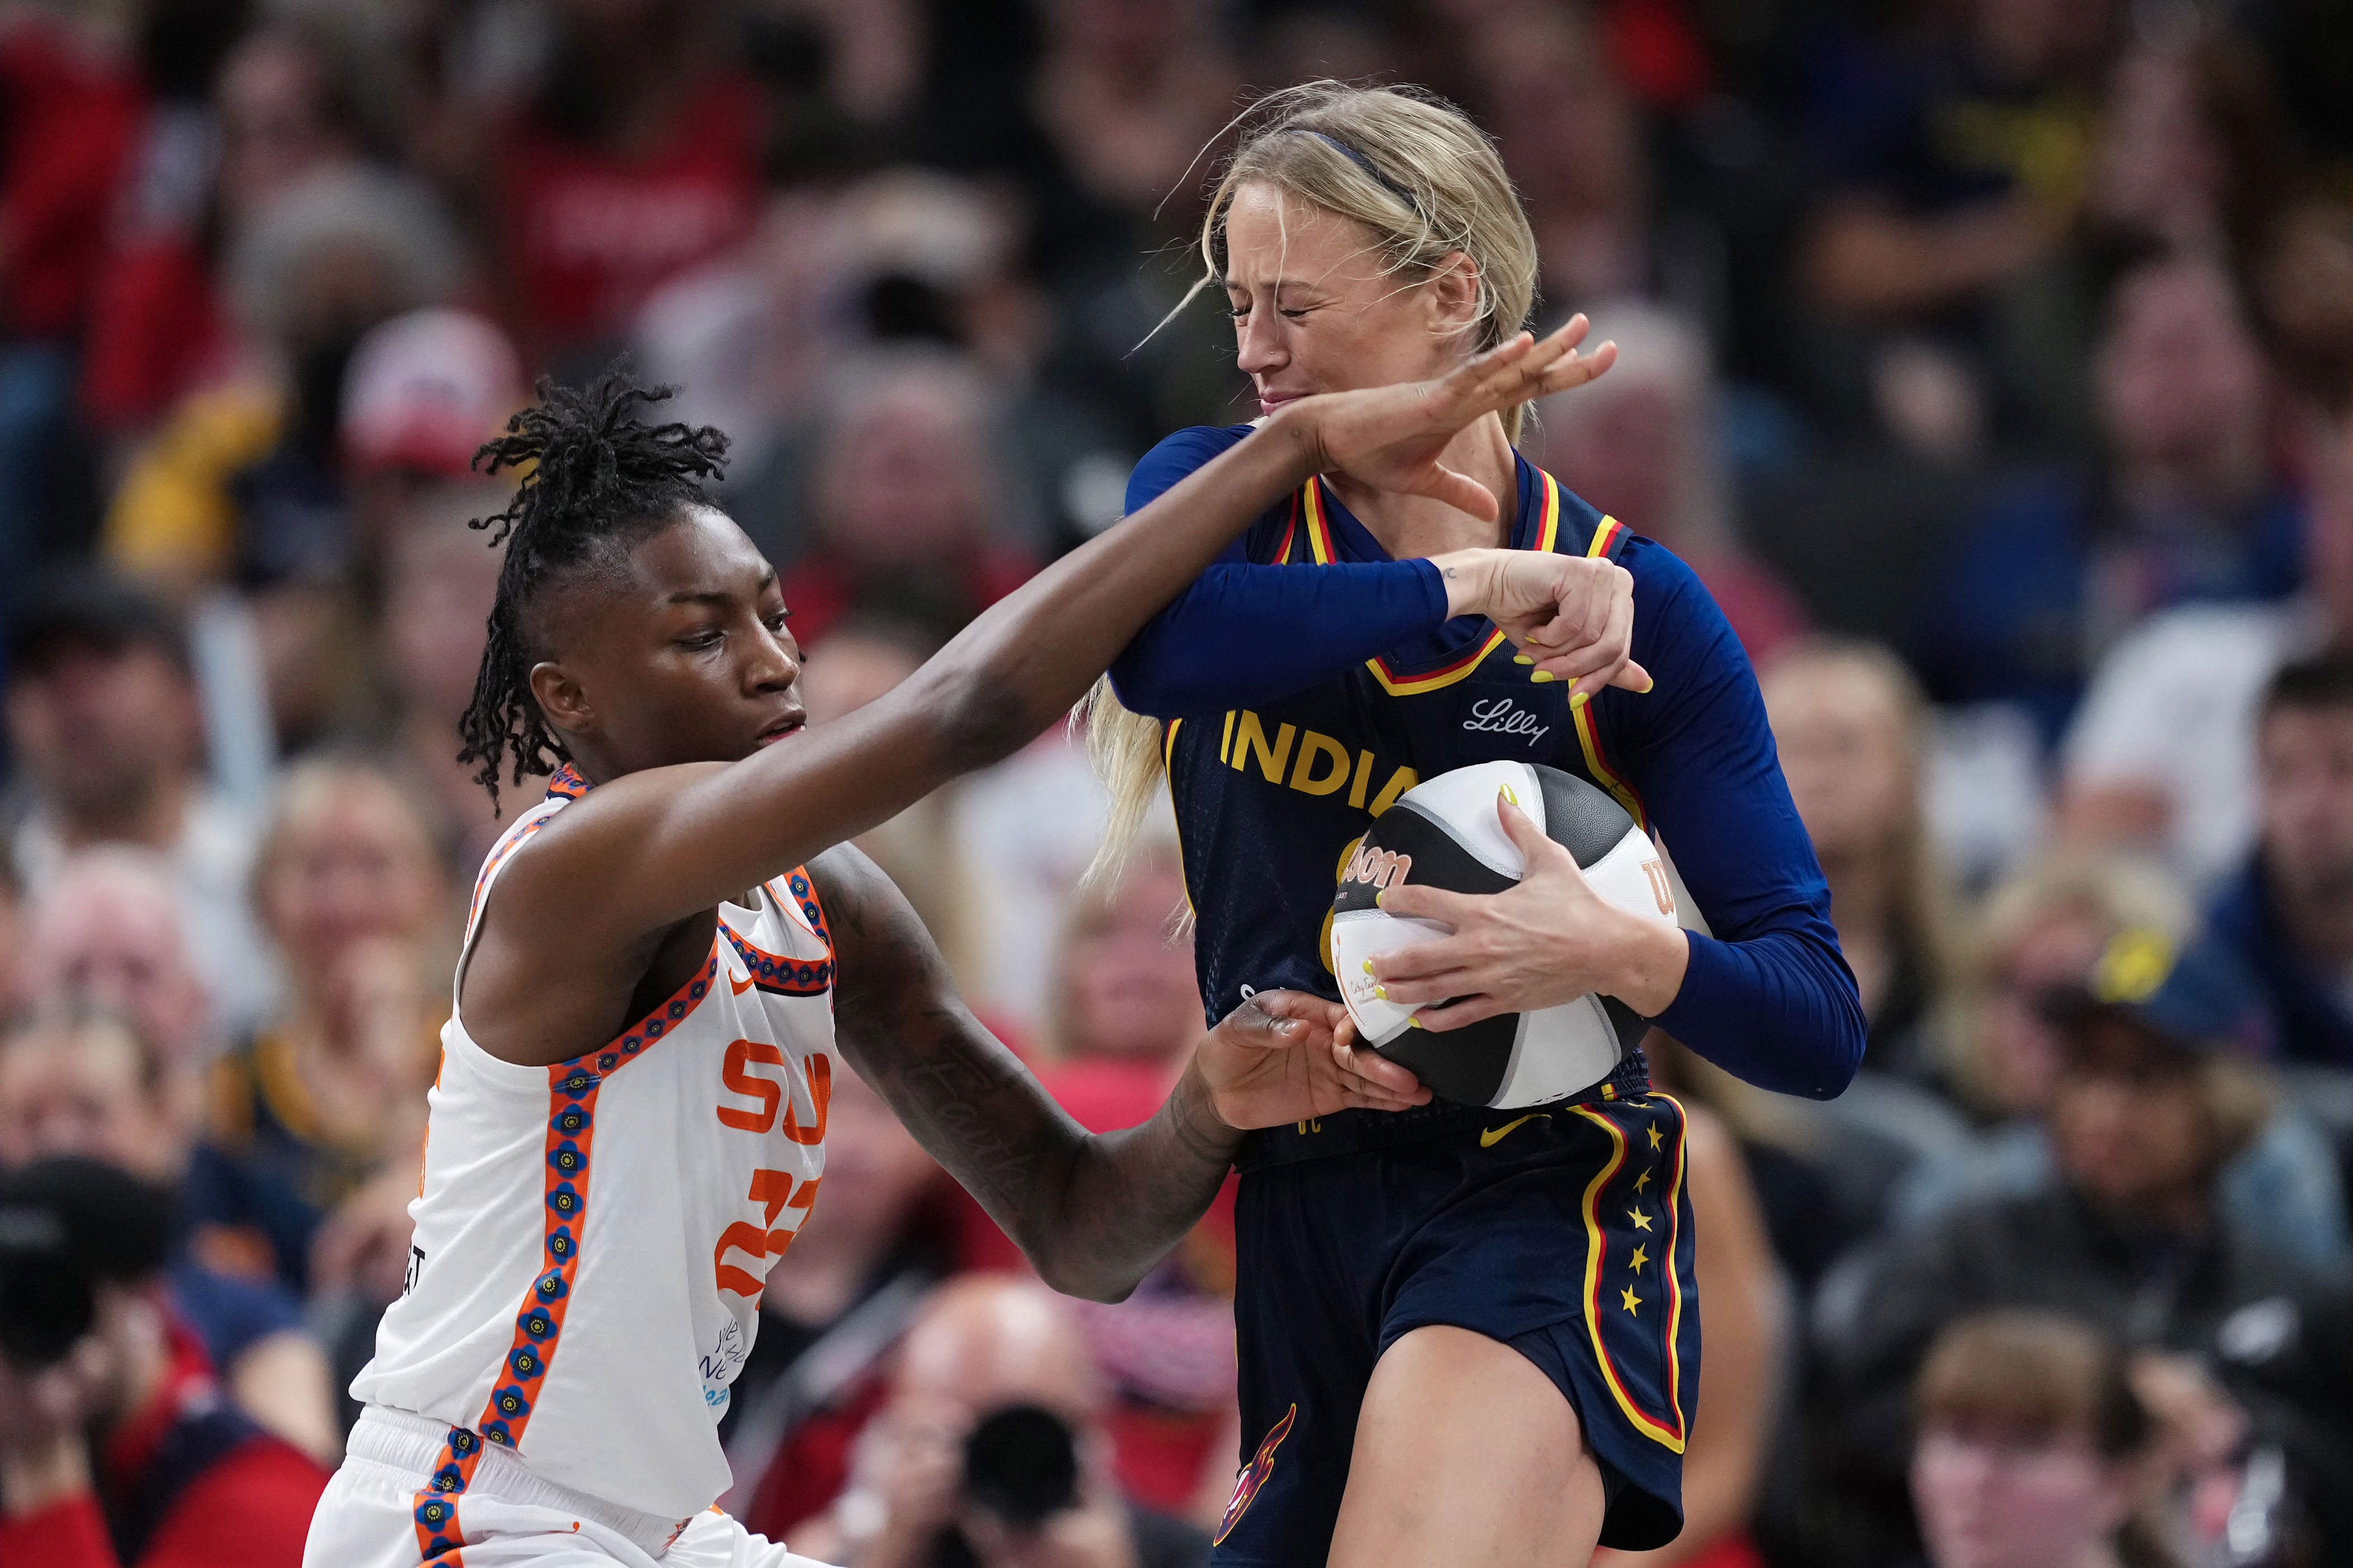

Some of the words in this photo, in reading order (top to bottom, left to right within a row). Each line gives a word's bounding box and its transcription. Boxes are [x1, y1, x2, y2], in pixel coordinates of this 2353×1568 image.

[1220, 709, 1420, 819] INDIA
[1463, 698, 1550, 747] Lilly
[1341, 829, 1412, 890] lson
[716, 1038, 832, 1146] SU
